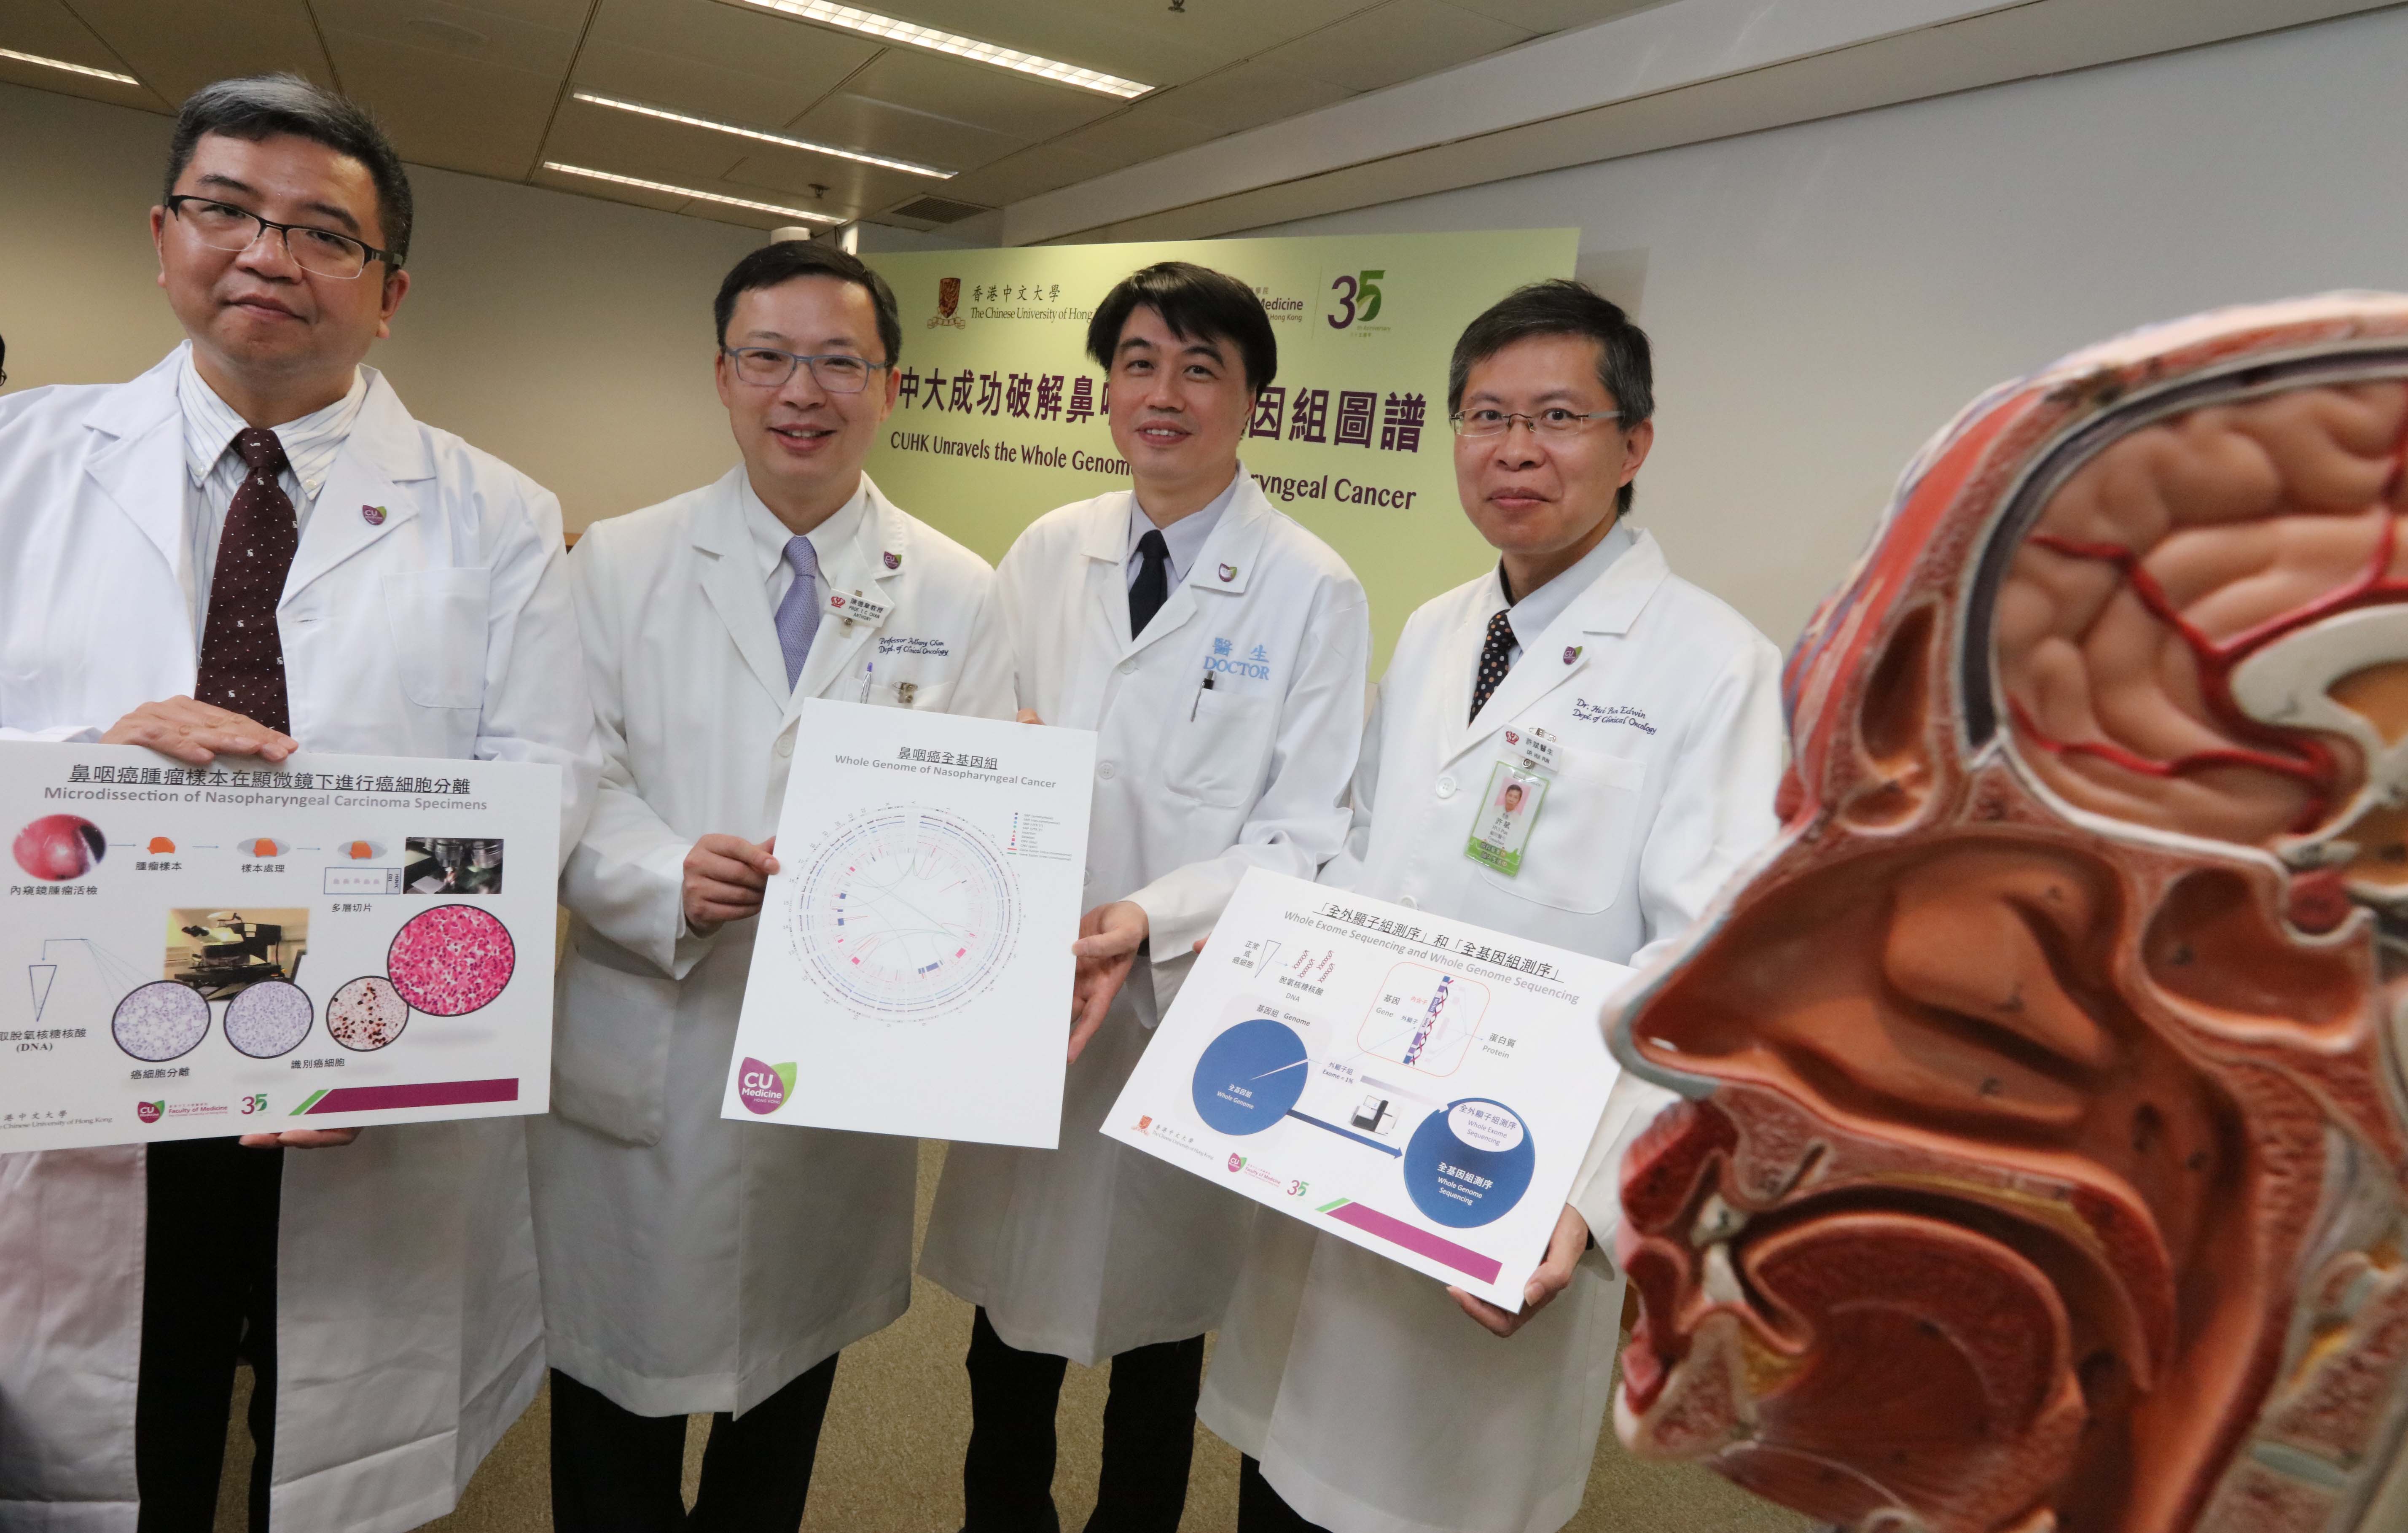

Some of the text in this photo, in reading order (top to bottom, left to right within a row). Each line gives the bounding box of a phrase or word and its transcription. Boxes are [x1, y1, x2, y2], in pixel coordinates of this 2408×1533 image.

[972, 283, 1061, 304] 香港中文大學
[1328, 270, 1386, 329] 35
[971, 307, 1093, 324] The Chinese University of Hong
[1287, 315, 1302, 323] Kong
[899, 366, 1427, 453] 中大成功破解鼻 因組圖譜
[890, 431, 1416, 510] CUHK Unravels the Whole Genom yngeal Cancer
[853, 613, 872, 621] ANTHONY
[879, 636, 907, 646] Professor
[896, 645, 903, 654] of
[922, 648, 949, 656] Oncology
[1212, 637, 1269, 663] 醫生
[1203, 656, 1270, 680] DOCTOR
[1576, 698, 1589, 710] Dr.
[1591, 705, 1606, 714] Hui
[1620, 706, 1646, 719] Edwin
[1572, 708, 1591, 721] Dept.
[1602, 715, 1629, 724] Clinical
[1629, 718, 1657, 735] Oncology
[897, 746, 998, 770] 鼻咽癌全基因組
[835, 754, 1056, 788] Whole Genome of Nasopharyngeal Cancer
[69, 764, 471, 795] 鼻咽癌腫瘤樣本在顯微鏡下進行癌細胞分離
[44, 786, 487, 811] Microdissection of Nasopharyngeal Carcinoma Specimens
[135, 860, 183, 871] 腫瘤樣本
[241, 863, 285, 874] 樣本處理
[10, 885, 98, 896] 內窺鏡腫瘤活檢
[332, 903, 372, 912] 多層切片
[1244, 941, 1260, 950] 正常
[1232, 956, 1254, 968] 癌細胞
[1284, 910, 1580, 1005] Whole Exome Sequencing and Whole Genome Sequencing
[1278, 976, 1325, 996] 脫氧核糖核酸
[1285, 992, 1300, 1002] DNA
[1383, 994, 1401, 1006] 基因
[1429, 998, 1439, 1011] Intron
[1256, 1004, 1279, 1018] 基因組
[1376, 1007, 1394, 1018] Gene
[1284, 1013, 1311, 1027] Genome
[1422, 1017, 1430, 1028] Exon
[16, 1042, 54, 1053] (DNA)
[1488, 1033, 1517, 1048] 蛋白質
[1482, 1045, 1510, 1059] Protein
[291, 1058, 345, 1070] 識別癌細胞
[1328, 1061, 1354, 1076] 外顯子組
[130, 1067, 190, 1080] 癌細胞分離
[744, 1072, 774, 1089] CU
[1322, 1069, 1340, 1080] Exome
[742, 1087, 782, 1099] Medicine
[1228, 1084, 1253, 1098] 全基因組
[241, 1093, 268, 1115] 35
[1217, 1090, 1254, 1109] Whole Genome
[1459, 1104, 1517, 1131] 全外顯子組測序
[1468, 1119, 1508, 1138] Whole Exome
[1467, 1128, 1501, 1146] Sequencing
[1437, 1162, 1494, 1190] 全基因組測序
[1287, 1179, 1310, 1197] 35
[1438, 1176, 1483, 1199] Whole Genome
[1438, 1187, 1473, 1206] Sequencing
